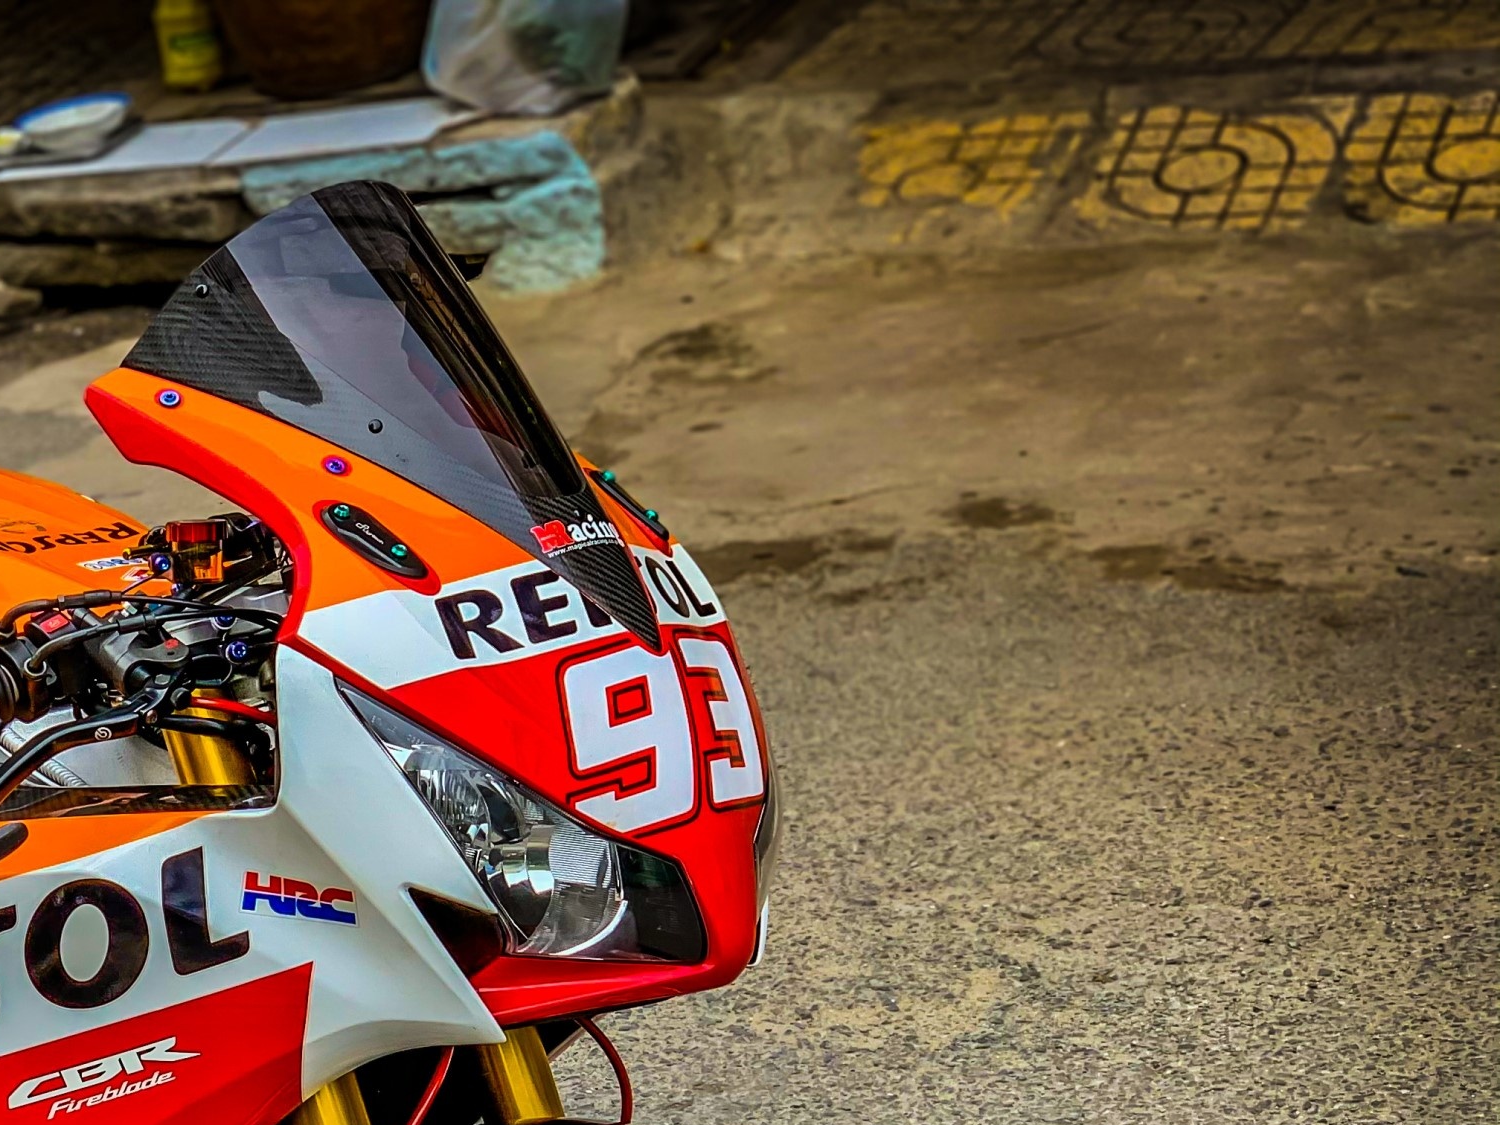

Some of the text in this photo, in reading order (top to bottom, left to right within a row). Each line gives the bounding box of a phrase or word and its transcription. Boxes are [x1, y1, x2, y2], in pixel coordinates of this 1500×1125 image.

[434, 554, 717, 660] REOL
[564, 638, 765, 834] 93
[242, 871, 357, 925] HRC
[8, 1036, 201, 1110] CBR
[47, 1071, 177, 1120] Fireblade
